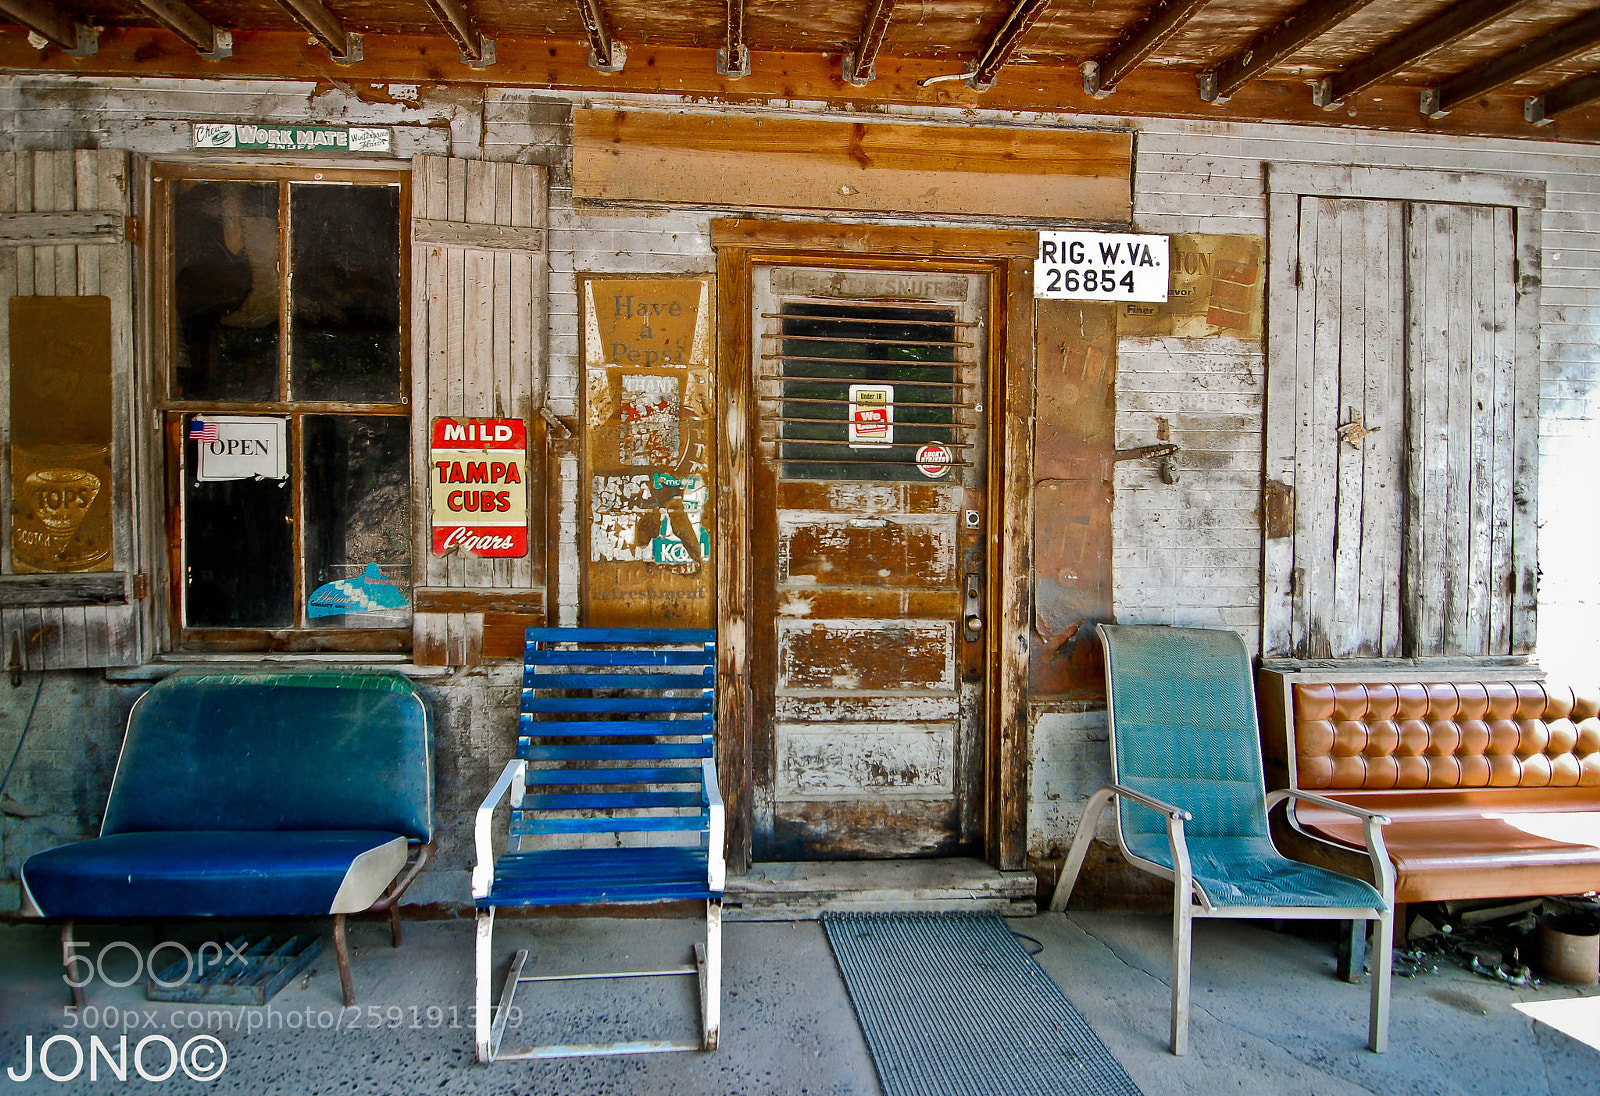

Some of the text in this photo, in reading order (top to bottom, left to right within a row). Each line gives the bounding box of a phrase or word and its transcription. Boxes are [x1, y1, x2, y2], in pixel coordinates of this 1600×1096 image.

[196, 125, 223, 142] Chew
[236, 125, 348, 147] WORK MATE
[1042, 240, 1161, 267] RIG. W.VA.
[1046, 268, 1135, 293] 26854
[613, 295, 682, 317] Have
[1126, 304, 1154, 315] Finer
[639, 325, 654, 340] a
[611, 342, 685, 366] Pepsi
[860, 411, 882, 421] We
[443, 424, 513, 442] MILD
[210, 438, 270, 456] OPEN
[435, 461, 522, 484] TAMPA
[35, 486, 88, 510] TOPS
[447, 489, 511, 512] CUBS
[443, 526, 514, 553] Cigars
[593, 586, 706, 600] refreshment
